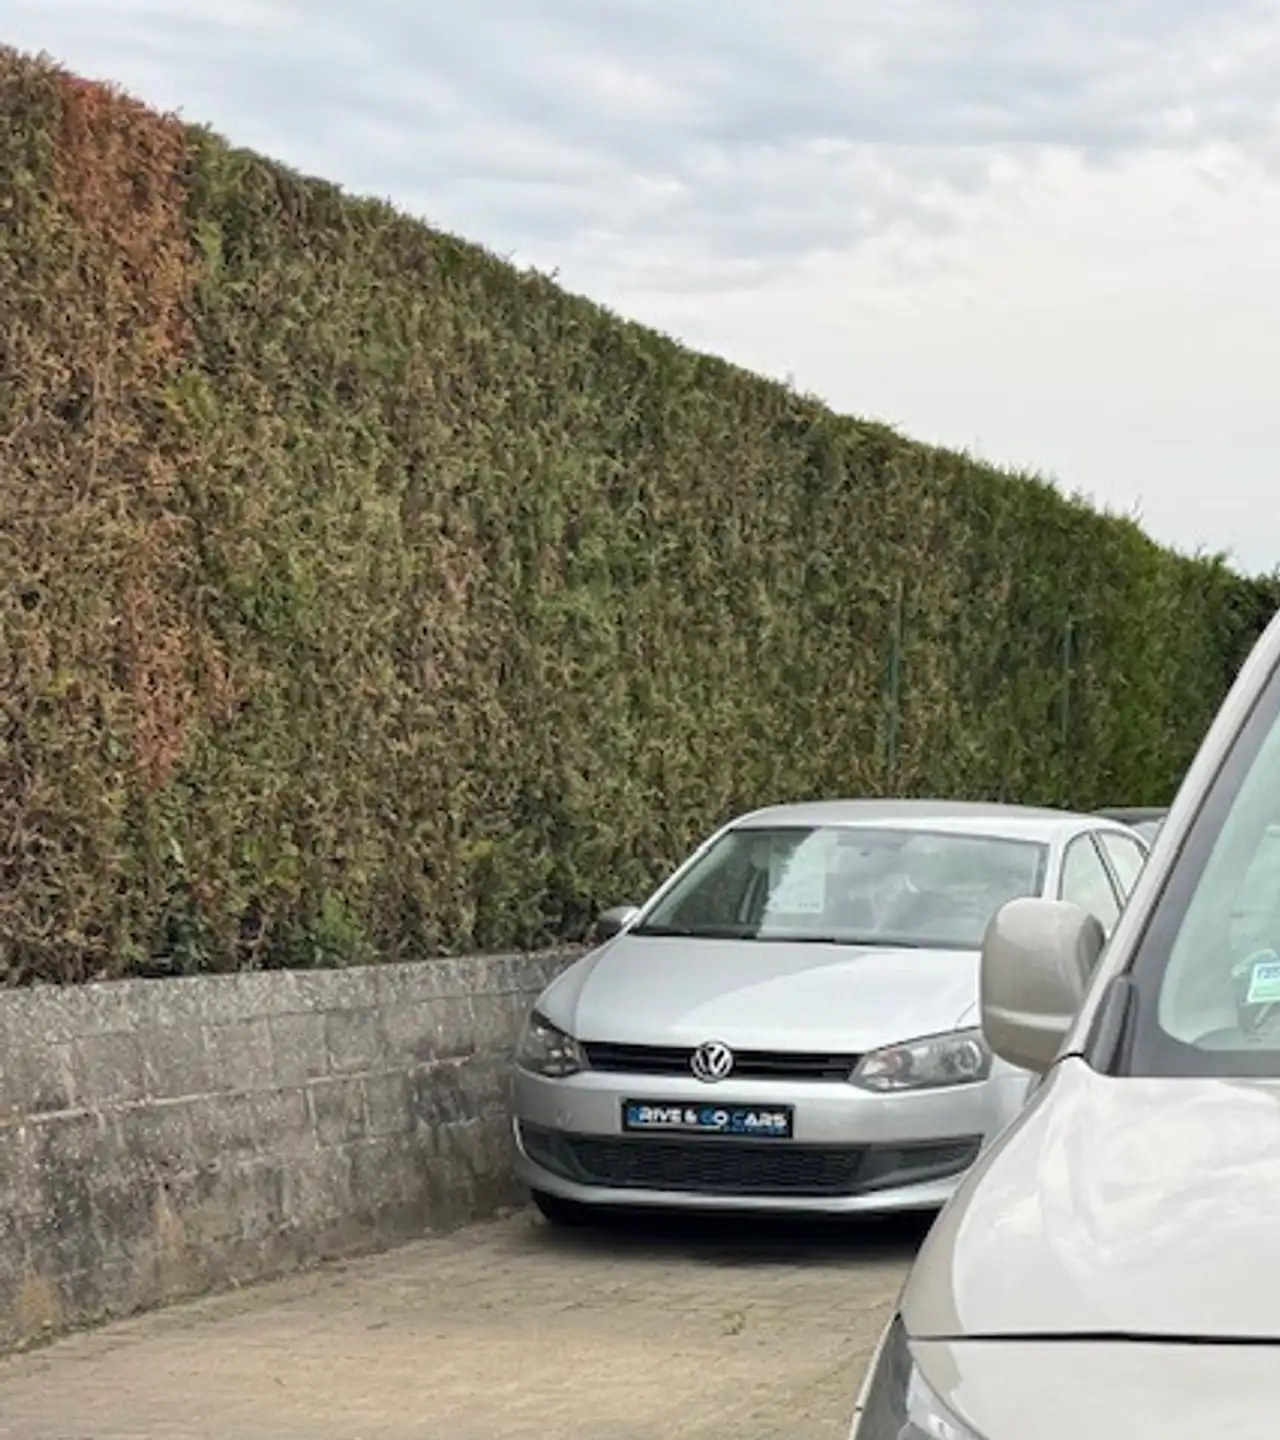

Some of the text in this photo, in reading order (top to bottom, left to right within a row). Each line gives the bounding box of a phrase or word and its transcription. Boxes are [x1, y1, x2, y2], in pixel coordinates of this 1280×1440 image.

[628, 1106, 788, 1127] DRIVE & GO CARS
